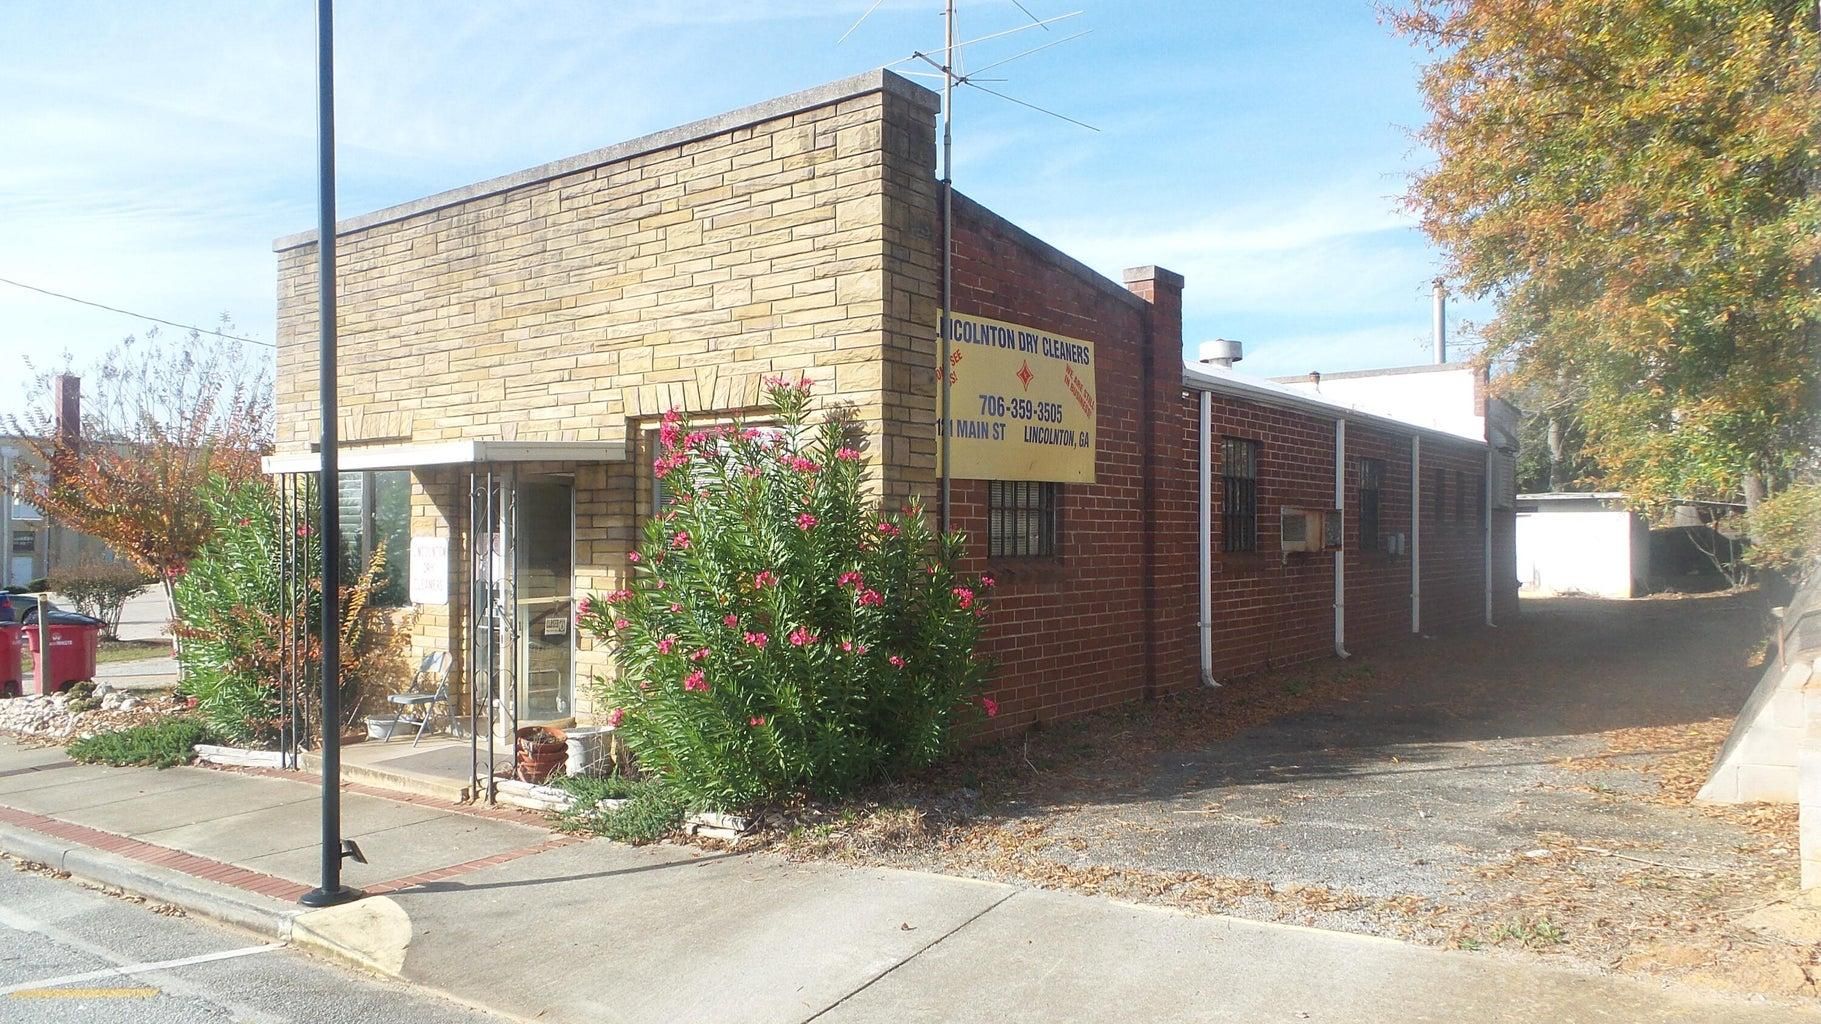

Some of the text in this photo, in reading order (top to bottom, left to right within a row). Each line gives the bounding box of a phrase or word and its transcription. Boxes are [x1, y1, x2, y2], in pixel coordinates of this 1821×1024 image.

[950, 348, 963, 366] SEE
[1018, 330, 1039, 354] DRY
[1042, 337, 1090, 365] CLEANERS
[979, 394, 1063, 424] 706-359-3505
[957, 420, 989, 440] MAIN
[992, 422, 1006, 441] ST
[1024, 426, 1090, 450] LINCOLNTON, GA
